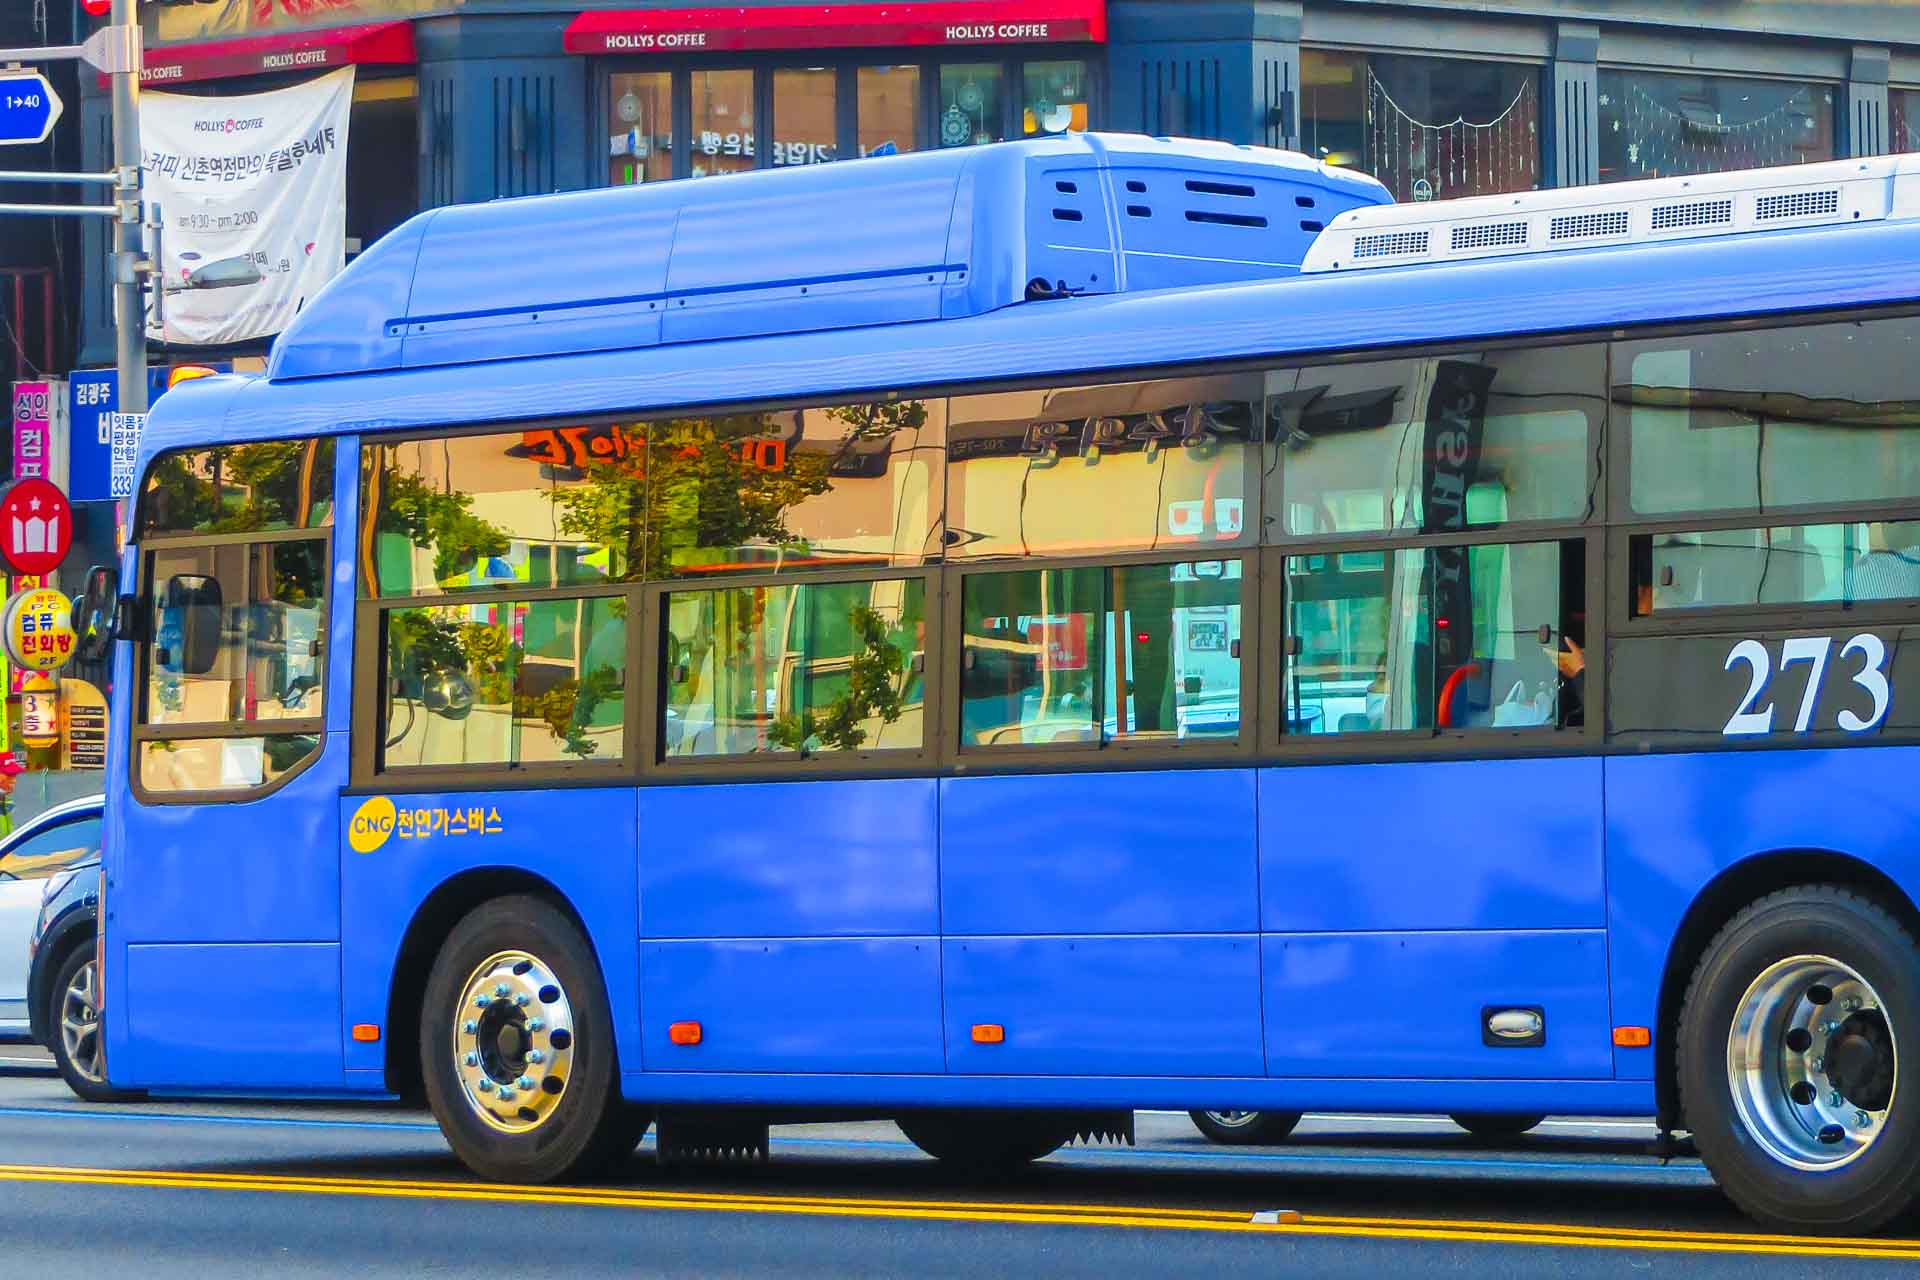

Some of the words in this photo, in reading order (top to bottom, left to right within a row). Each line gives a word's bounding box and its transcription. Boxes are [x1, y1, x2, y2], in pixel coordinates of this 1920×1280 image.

[946, 25, 995, 39] HOLLYS
[998, 24, 1048, 37] COFFEE
[606, 34, 655, 48] HOLLYS
[657, 33, 706, 47] COFFEE
[263, 52, 294, 68] HOLLYS
[295, 50, 327, 64] COFFEE
[153, 65, 183, 80] COFFEE
[193, 119, 225, 132] HOLLYS
[235, 117, 264, 131] COFFEE
[233, 210, 259, 226] 2:00
[17, 393, 49, 421] 성인
[22, 633, 72, 656] 전화방
[39, 656, 57, 666] 2F
[1722, 632, 1892, 737] 273
[353, 814, 392, 835] CNG
[397, 807, 504, 839] 천연가스버스
